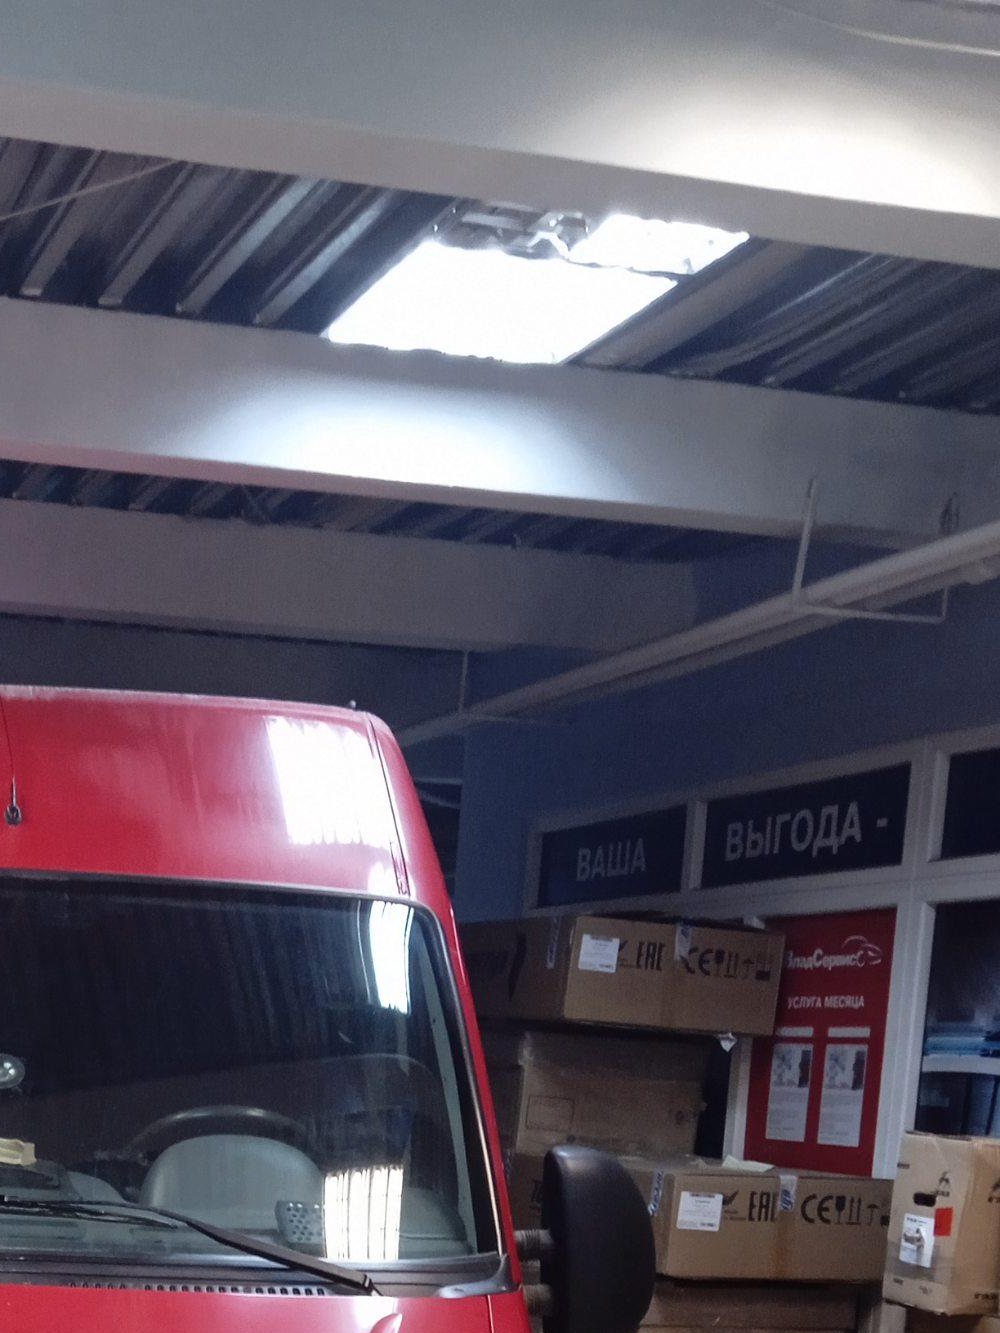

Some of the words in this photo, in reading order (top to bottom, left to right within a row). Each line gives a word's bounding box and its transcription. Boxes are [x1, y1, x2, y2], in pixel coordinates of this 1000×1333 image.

[576, 838, 647, 882] ВАША
[725, 800, 862, 862] ВЫГОДА
[787, 996, 822, 1009] УСЛУГА
[824, 995, 865, 1009] МЕСЯЦА
